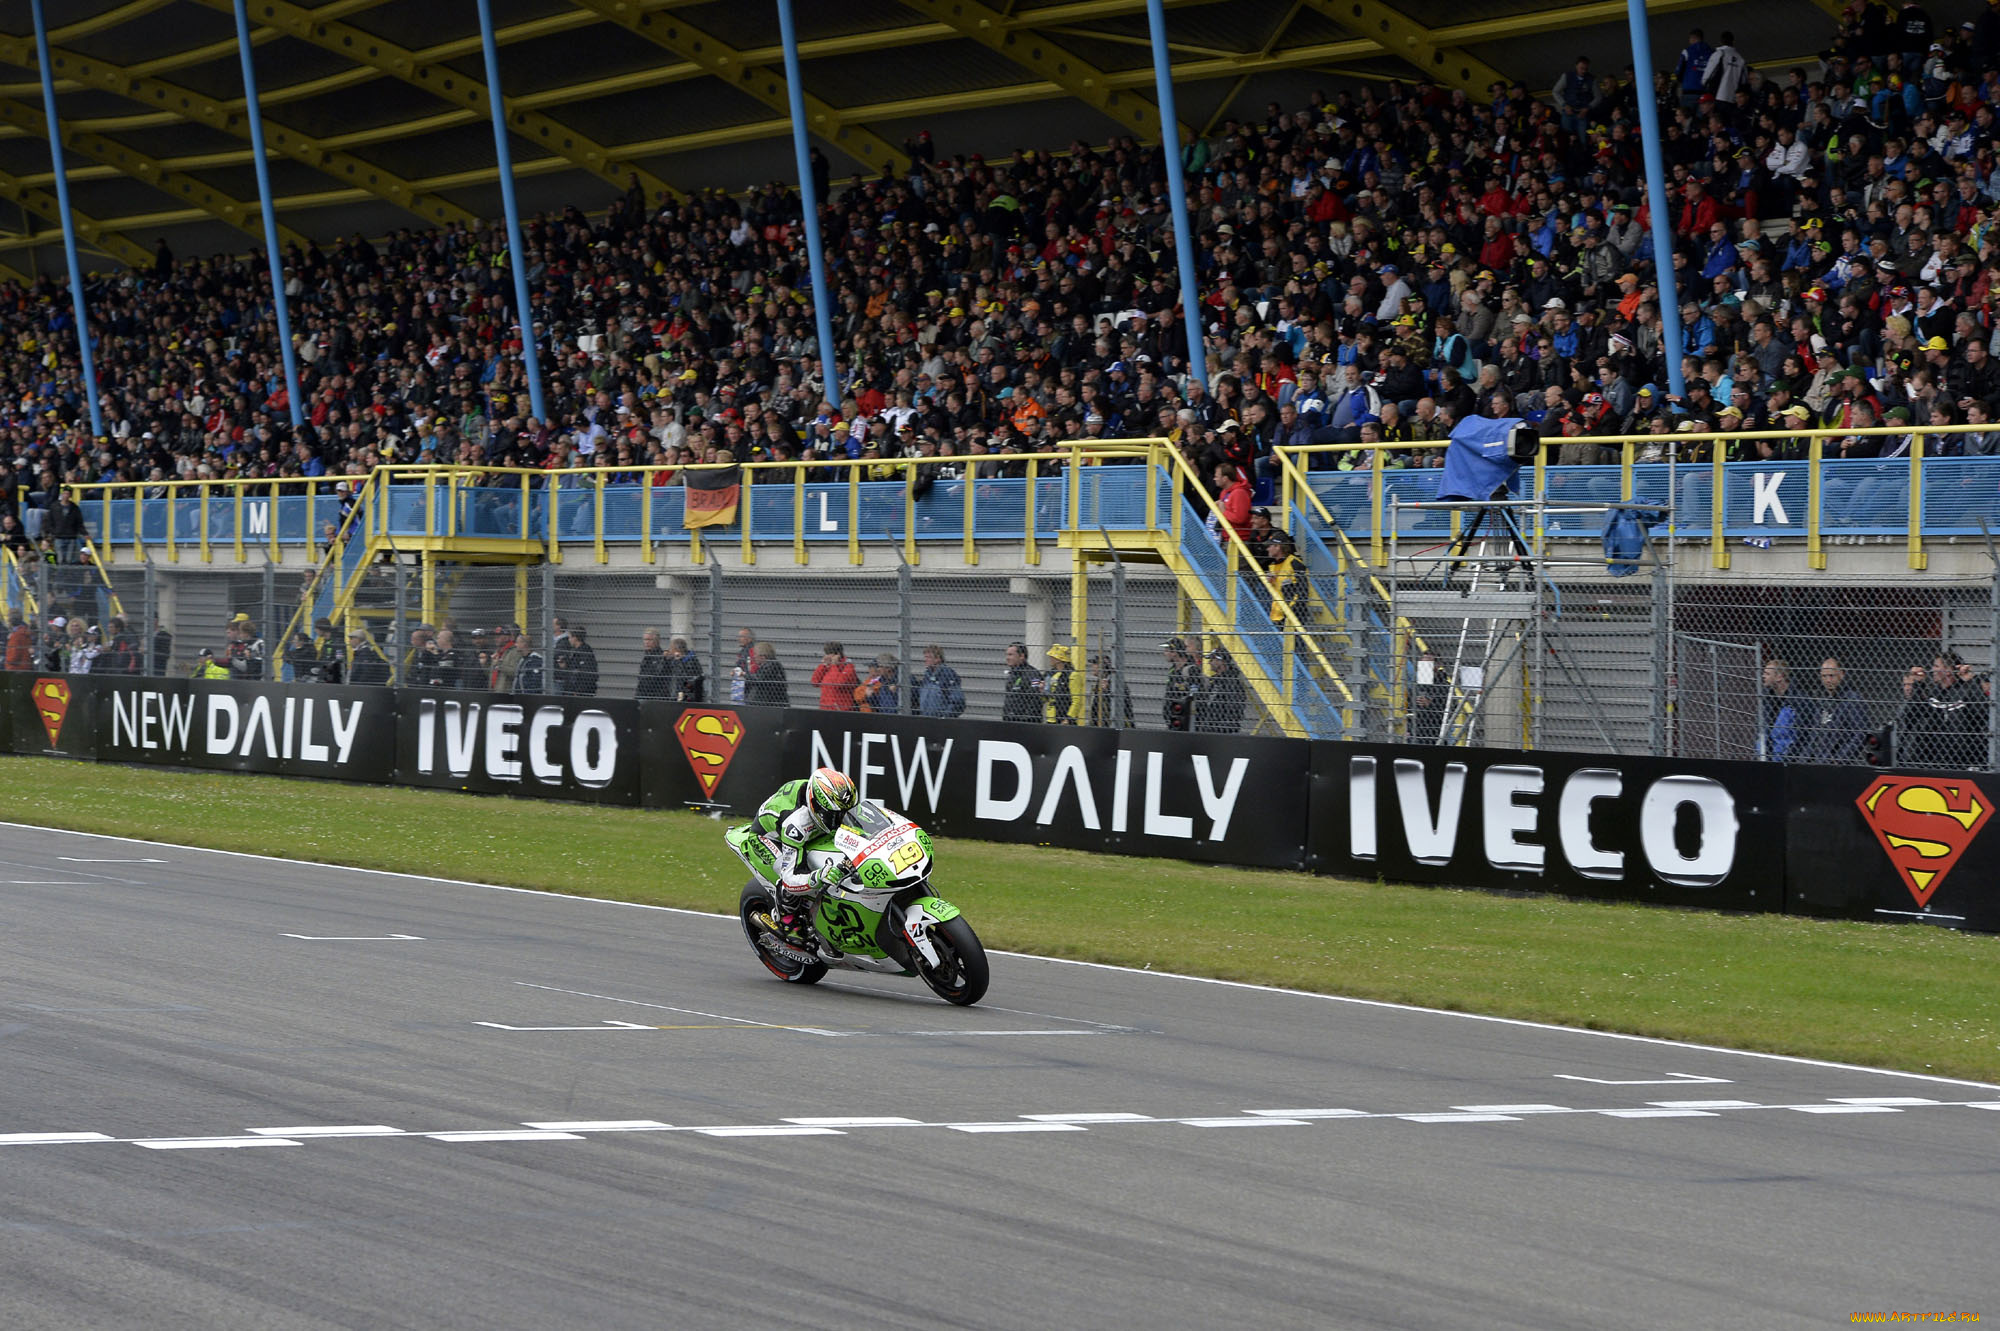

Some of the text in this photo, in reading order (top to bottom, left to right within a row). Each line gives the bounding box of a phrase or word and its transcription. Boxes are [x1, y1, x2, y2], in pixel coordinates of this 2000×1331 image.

[249, 502, 268, 534] M
[820, 491, 838, 531] L
[1753, 472, 1789, 524] K
[112, 690, 363, 763] NEW DAILY
[418, 699, 618, 788] IVECO
[811, 730, 1250, 842] NEW DAILY
[863, 824, 914, 856] BARRACUDA
[1350, 755, 1739, 888] IVECO
[864, 862, 884, 881] GO
[888, 841, 925, 876] 19
